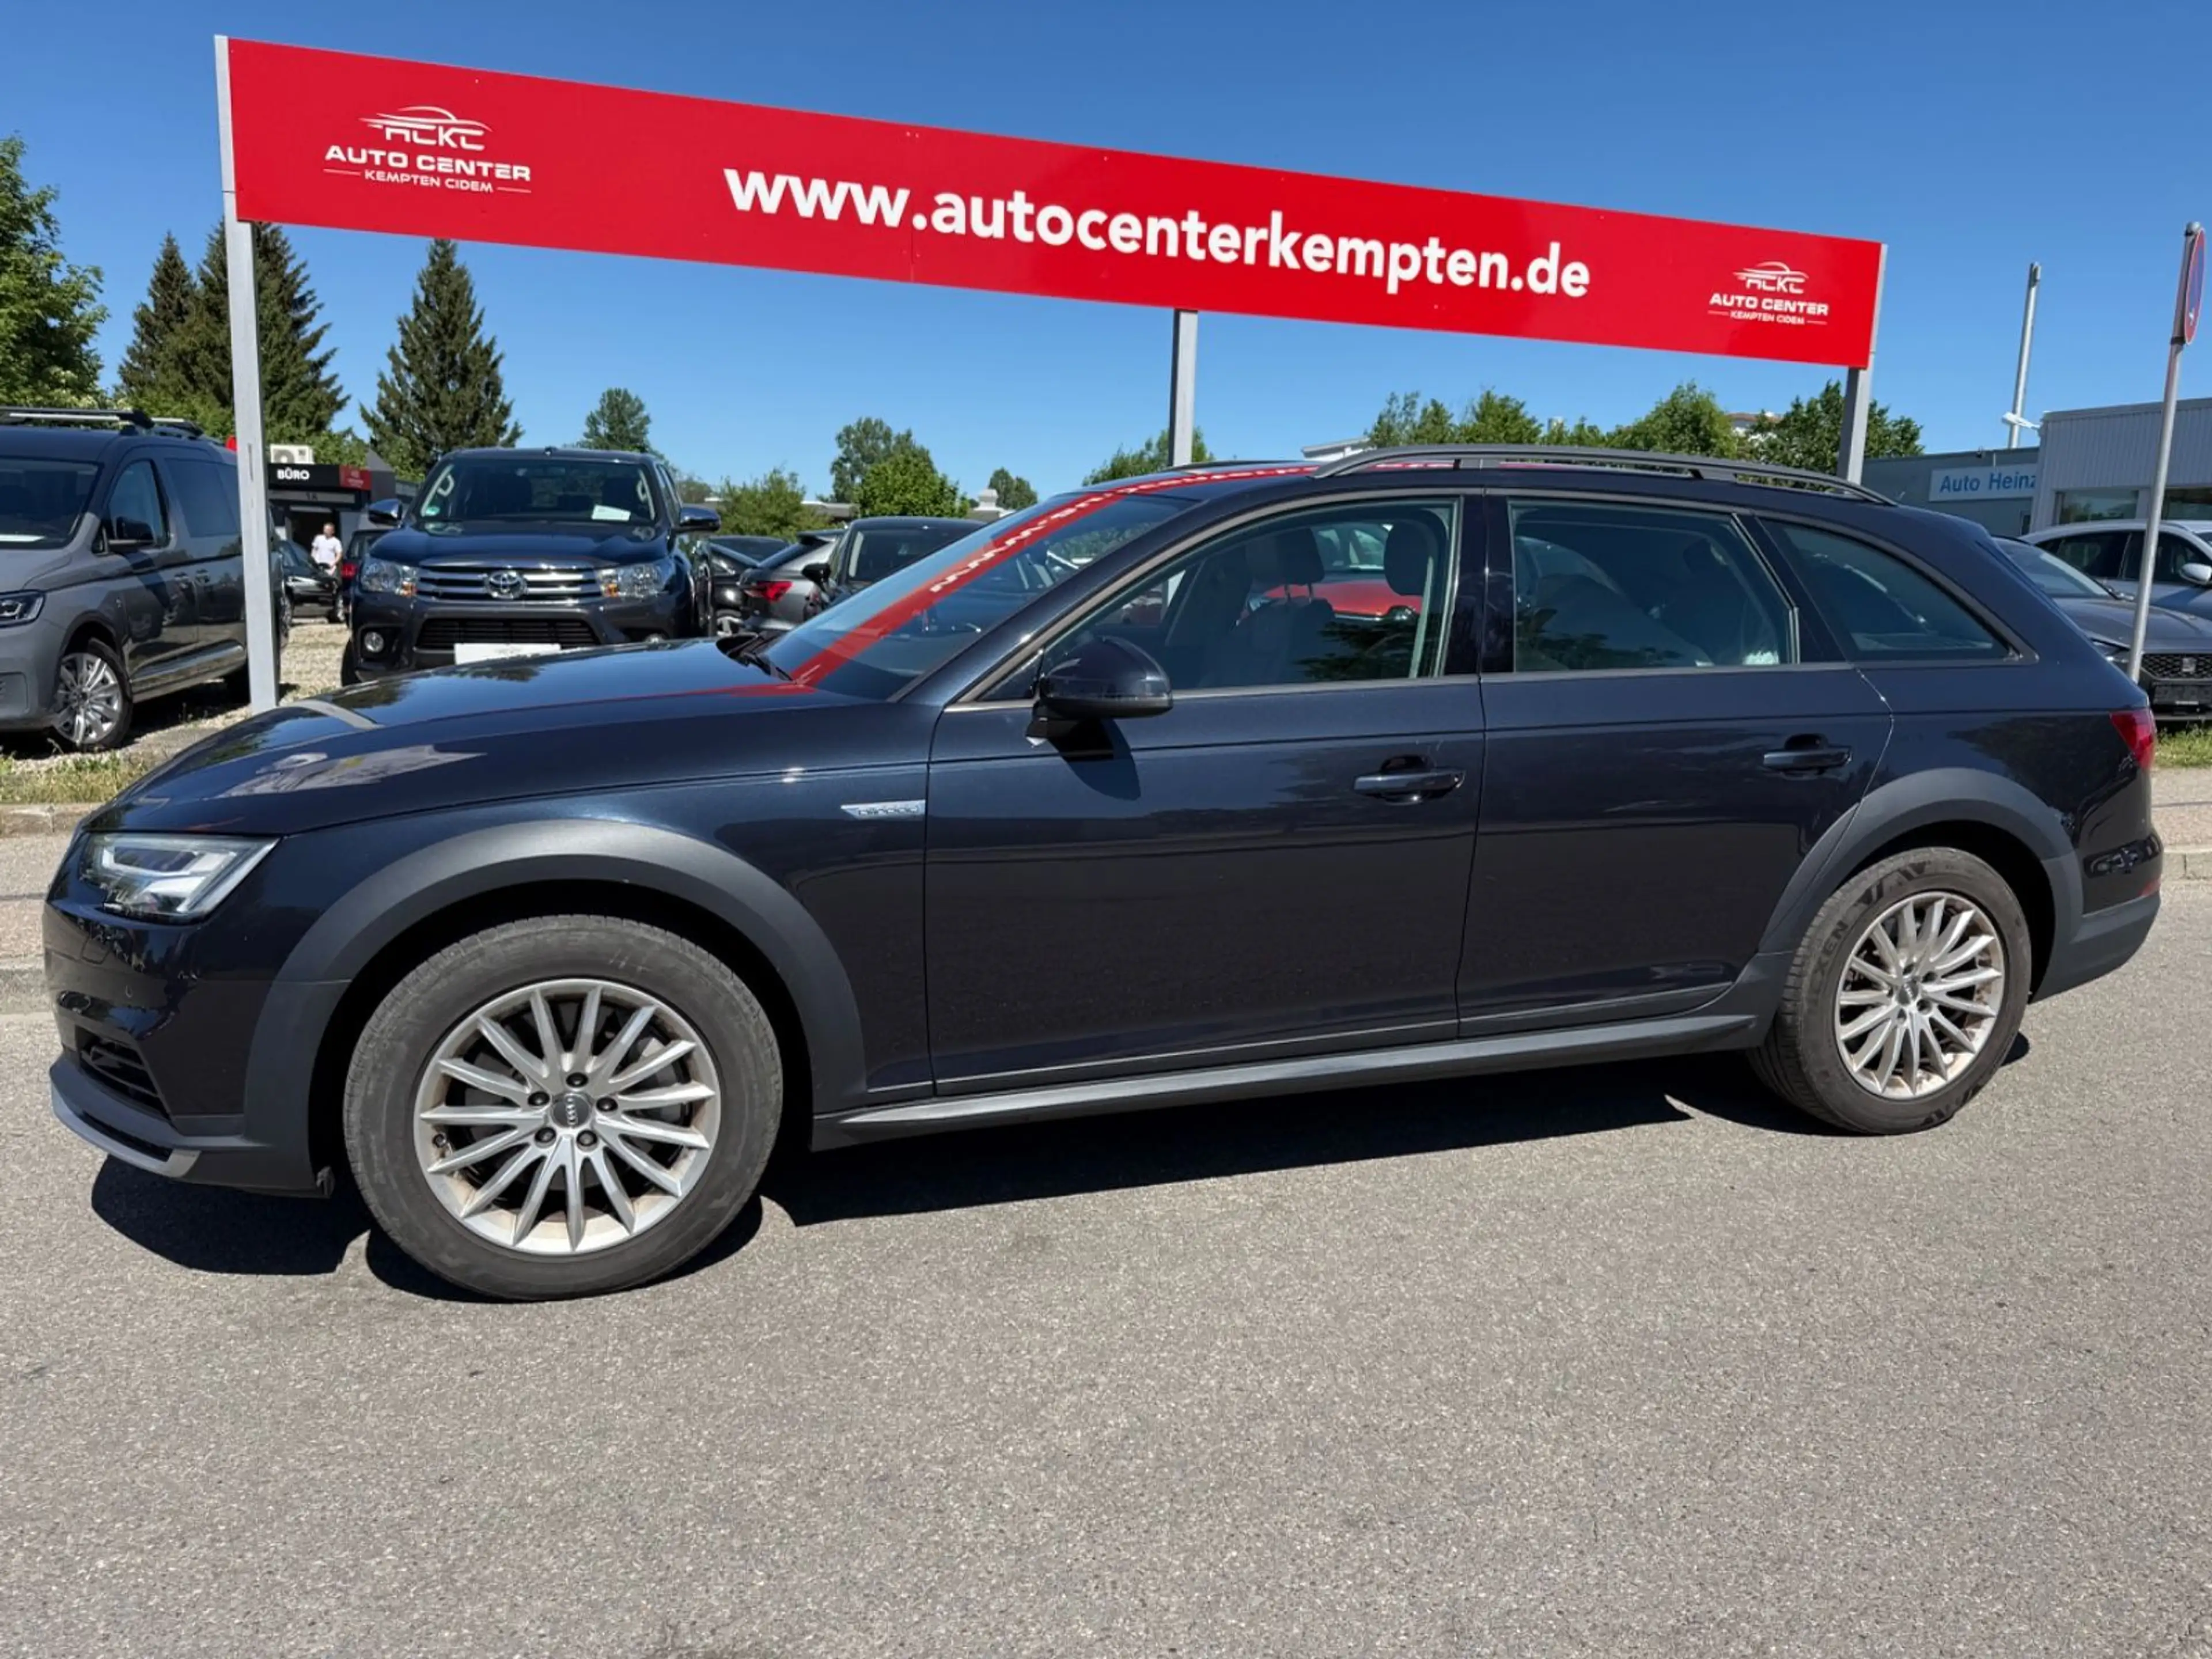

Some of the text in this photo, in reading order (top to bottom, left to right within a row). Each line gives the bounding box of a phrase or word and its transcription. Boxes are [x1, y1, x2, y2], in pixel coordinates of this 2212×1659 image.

[325, 145, 531, 181] AUTO CENTER
[365, 170, 493, 193] KEMPTEN CIDEM
[723, 168, 1590, 297] www.autocenterkempten.de
[1709, 293, 1829, 316] AUTO CENTER
[1730, 310, 1805, 325] KEMPTEN CIDEM
[276, 466, 310, 480] BÜRO
[1940, 475, 1980, 494] Auto
